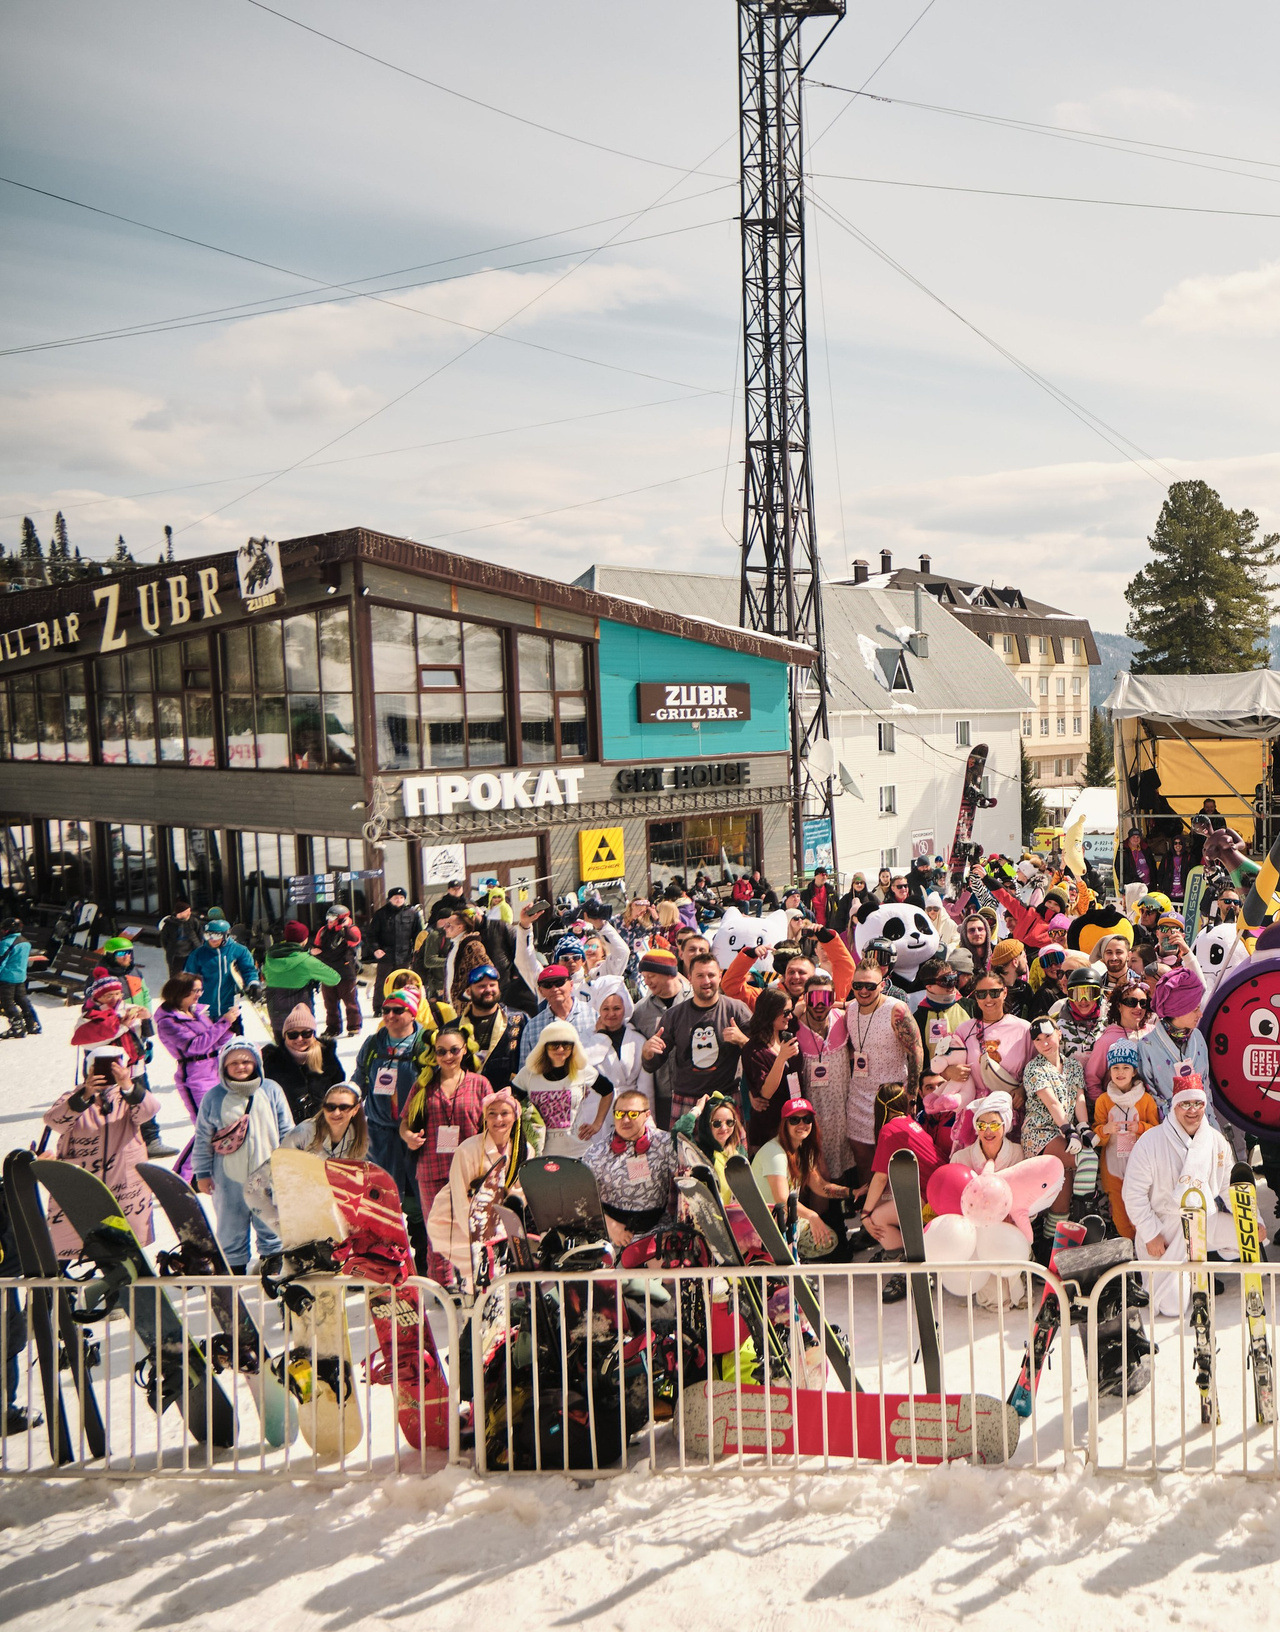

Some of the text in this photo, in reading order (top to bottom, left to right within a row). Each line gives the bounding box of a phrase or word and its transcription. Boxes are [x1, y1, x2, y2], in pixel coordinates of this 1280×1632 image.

[37, 614, 80, 651] BAR
[92, 566, 223, 653] ZUBR
[246, 593, 277, 612] ZUBR
[665, 685, 727, 706] ZUBR
[617, 761, 751, 794] SKI HOUSE
[403, 767, 585, 817] ПРОКАТ
[587, 863, 621, 872] FISCHER
[1189, 876, 1200, 911] ROSSI
[1214, 1033, 1229, 1055] 9
[1251, 1064, 1279, 1077] FEST
[1234, 1183, 1258, 1262] FISCHER
